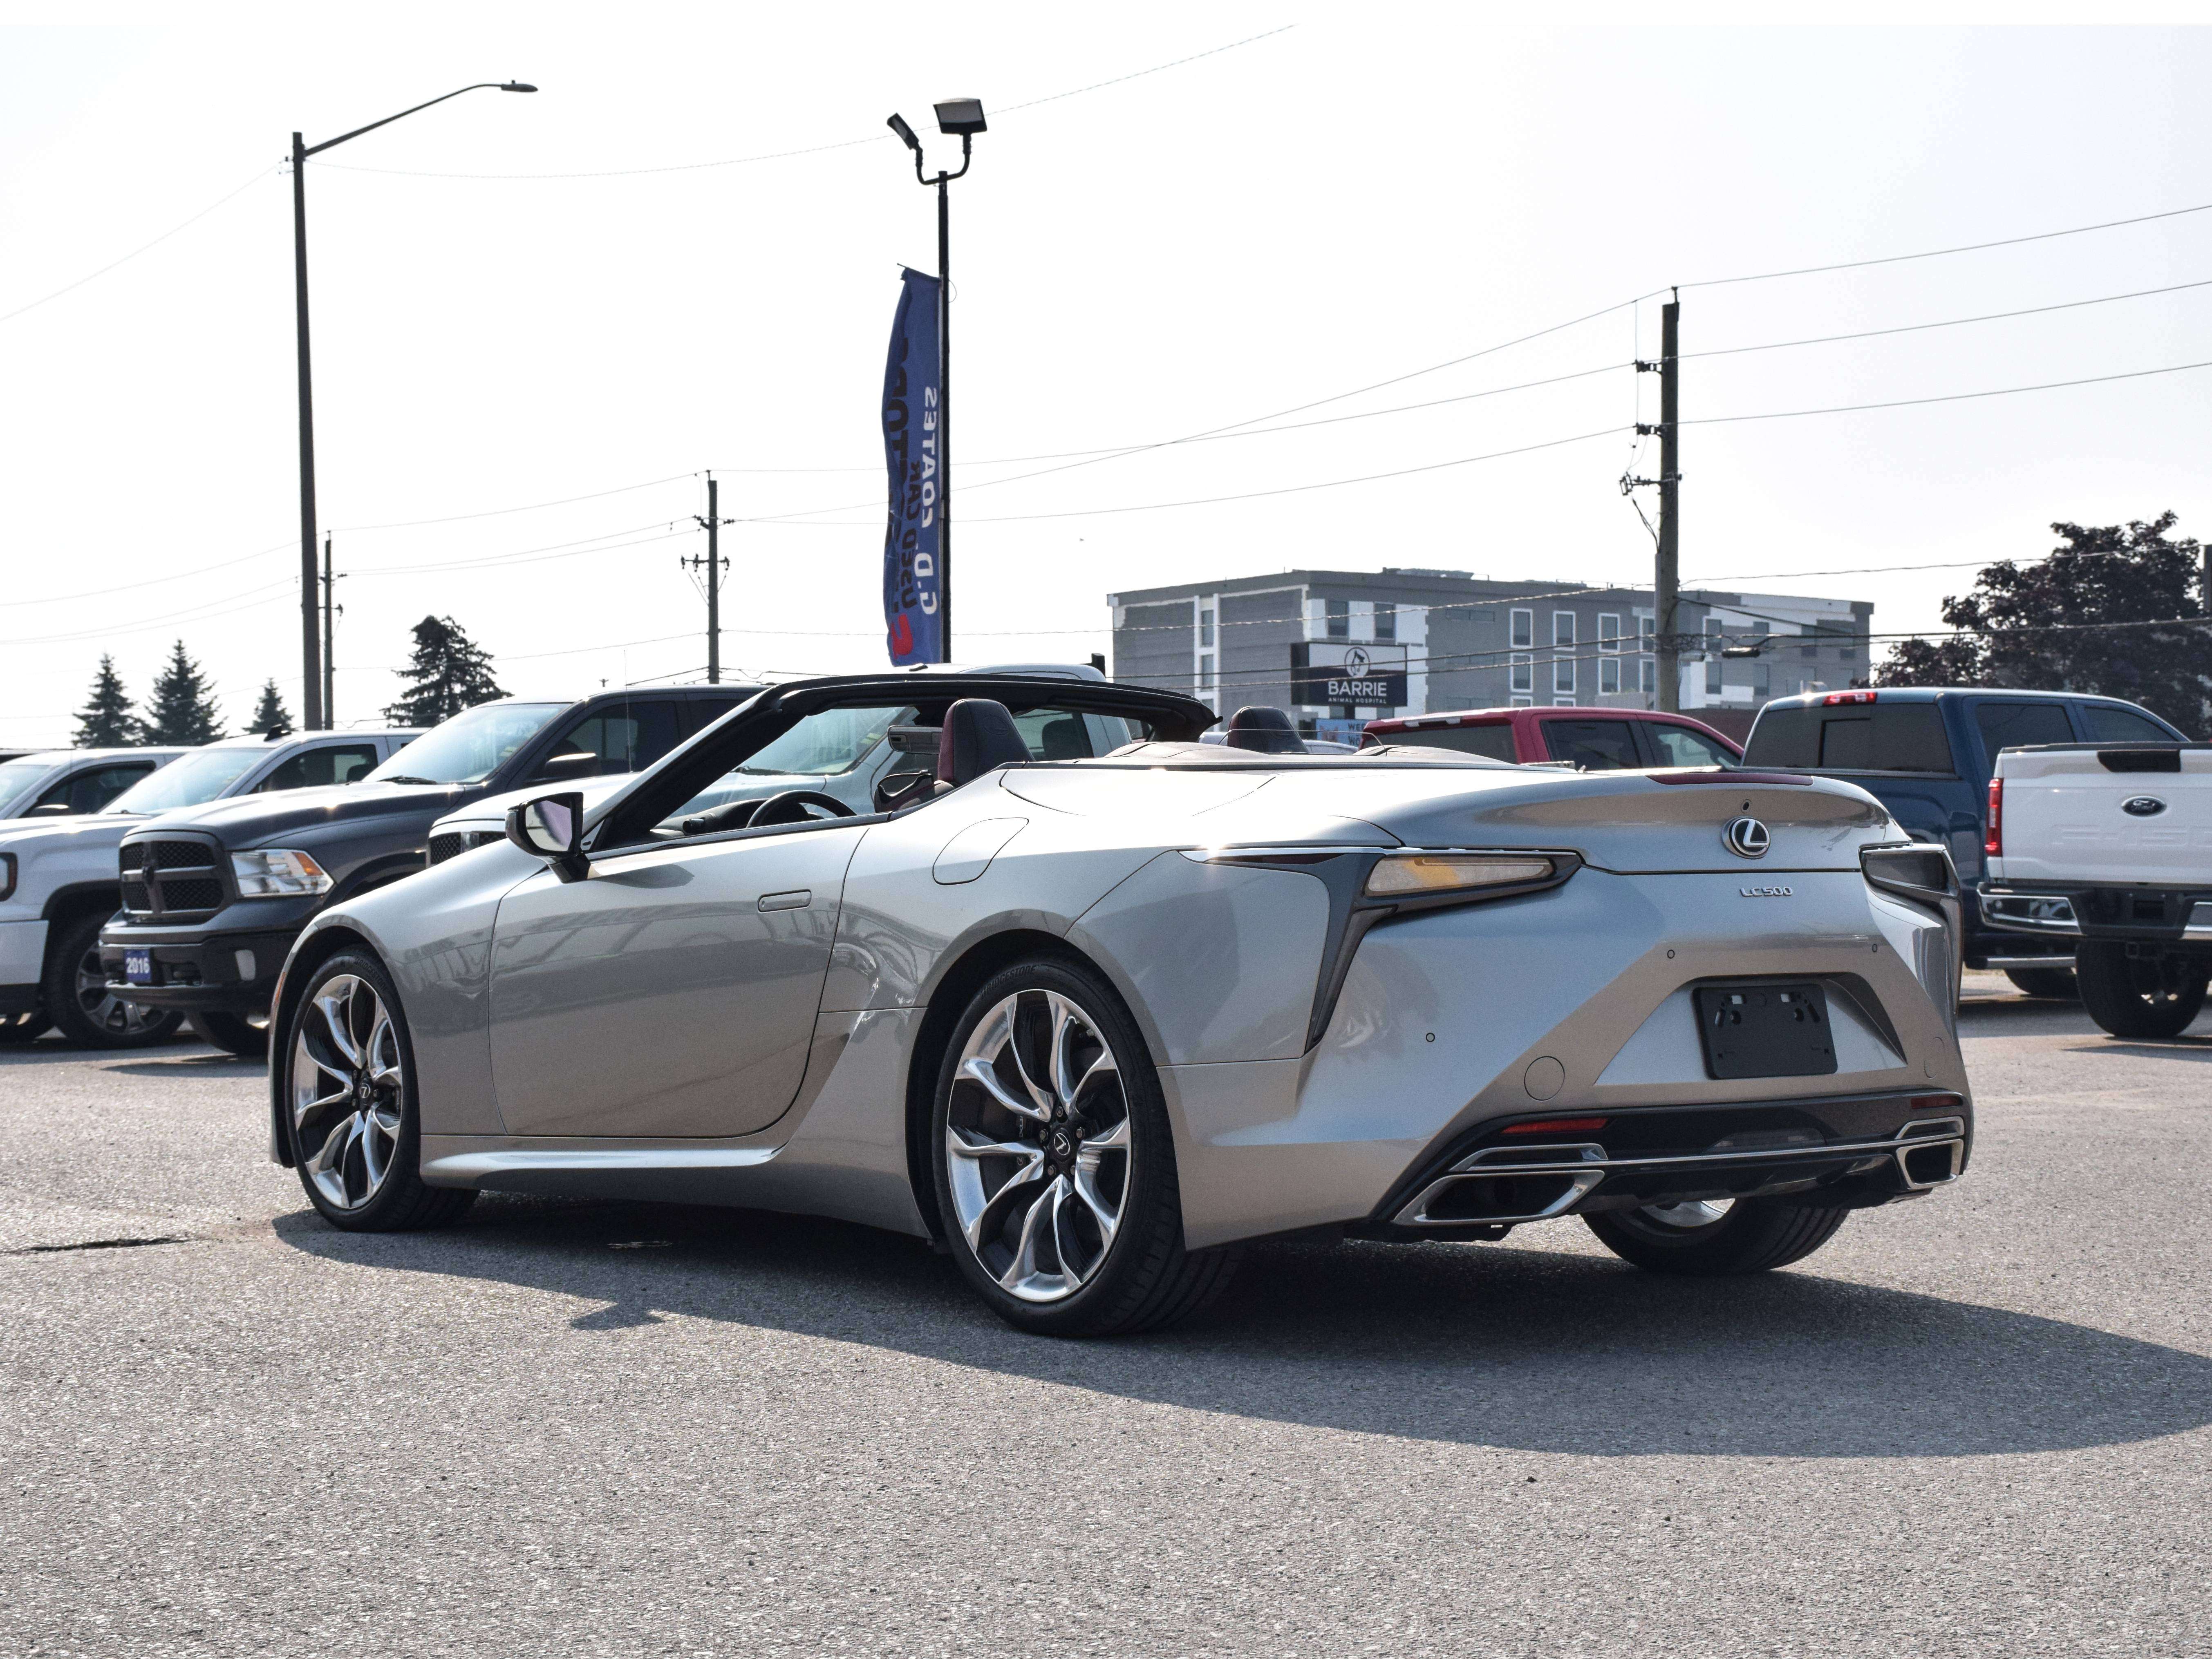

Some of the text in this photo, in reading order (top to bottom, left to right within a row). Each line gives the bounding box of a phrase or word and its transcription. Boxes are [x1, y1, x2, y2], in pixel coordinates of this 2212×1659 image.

[1328, 681, 1387, 696] BARRIE
[1740, 887, 1793, 897] LC500
[126, 957, 150, 974] 2016
